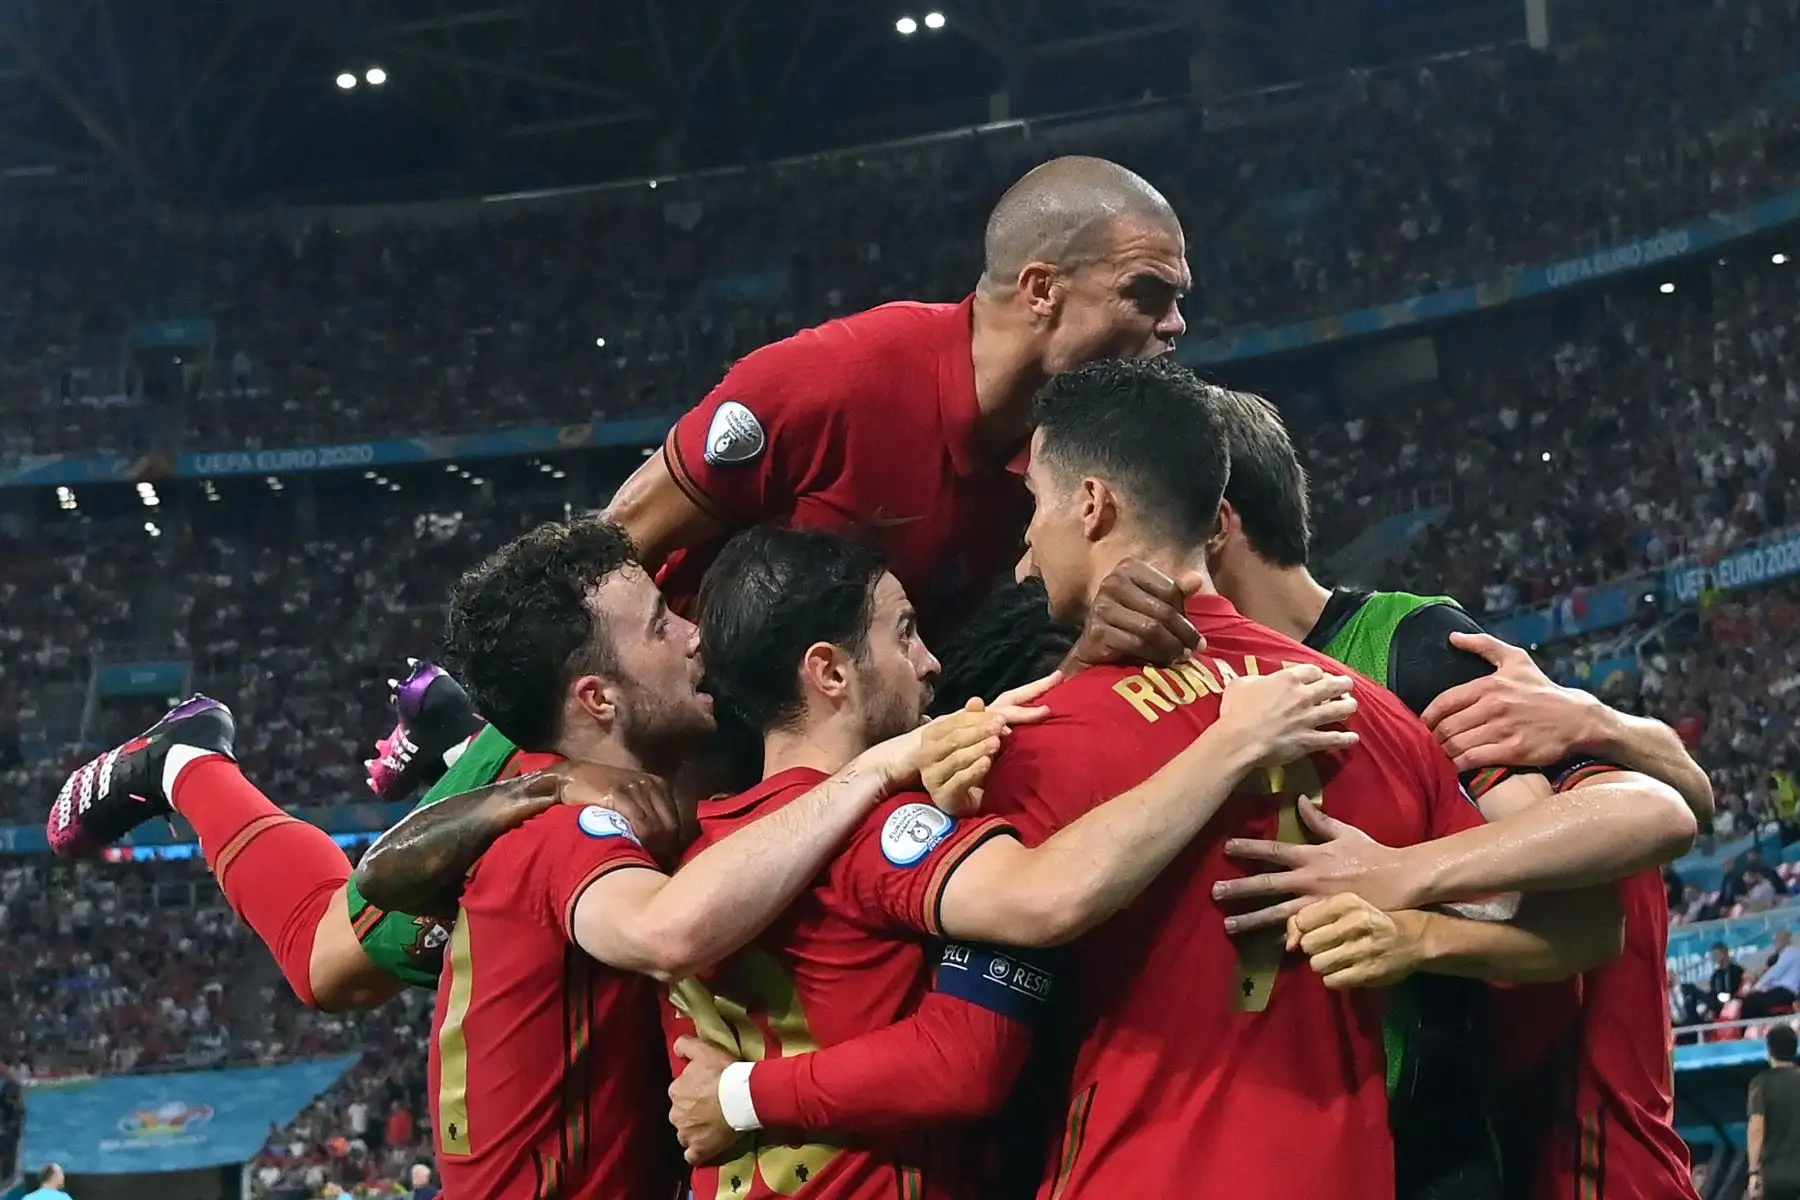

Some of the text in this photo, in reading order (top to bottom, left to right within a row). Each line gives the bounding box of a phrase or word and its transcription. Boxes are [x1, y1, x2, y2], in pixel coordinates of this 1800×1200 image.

[195, 444, 374, 474] UEFA EURO 2020
[1719, 550, 1764, 587] EURO
